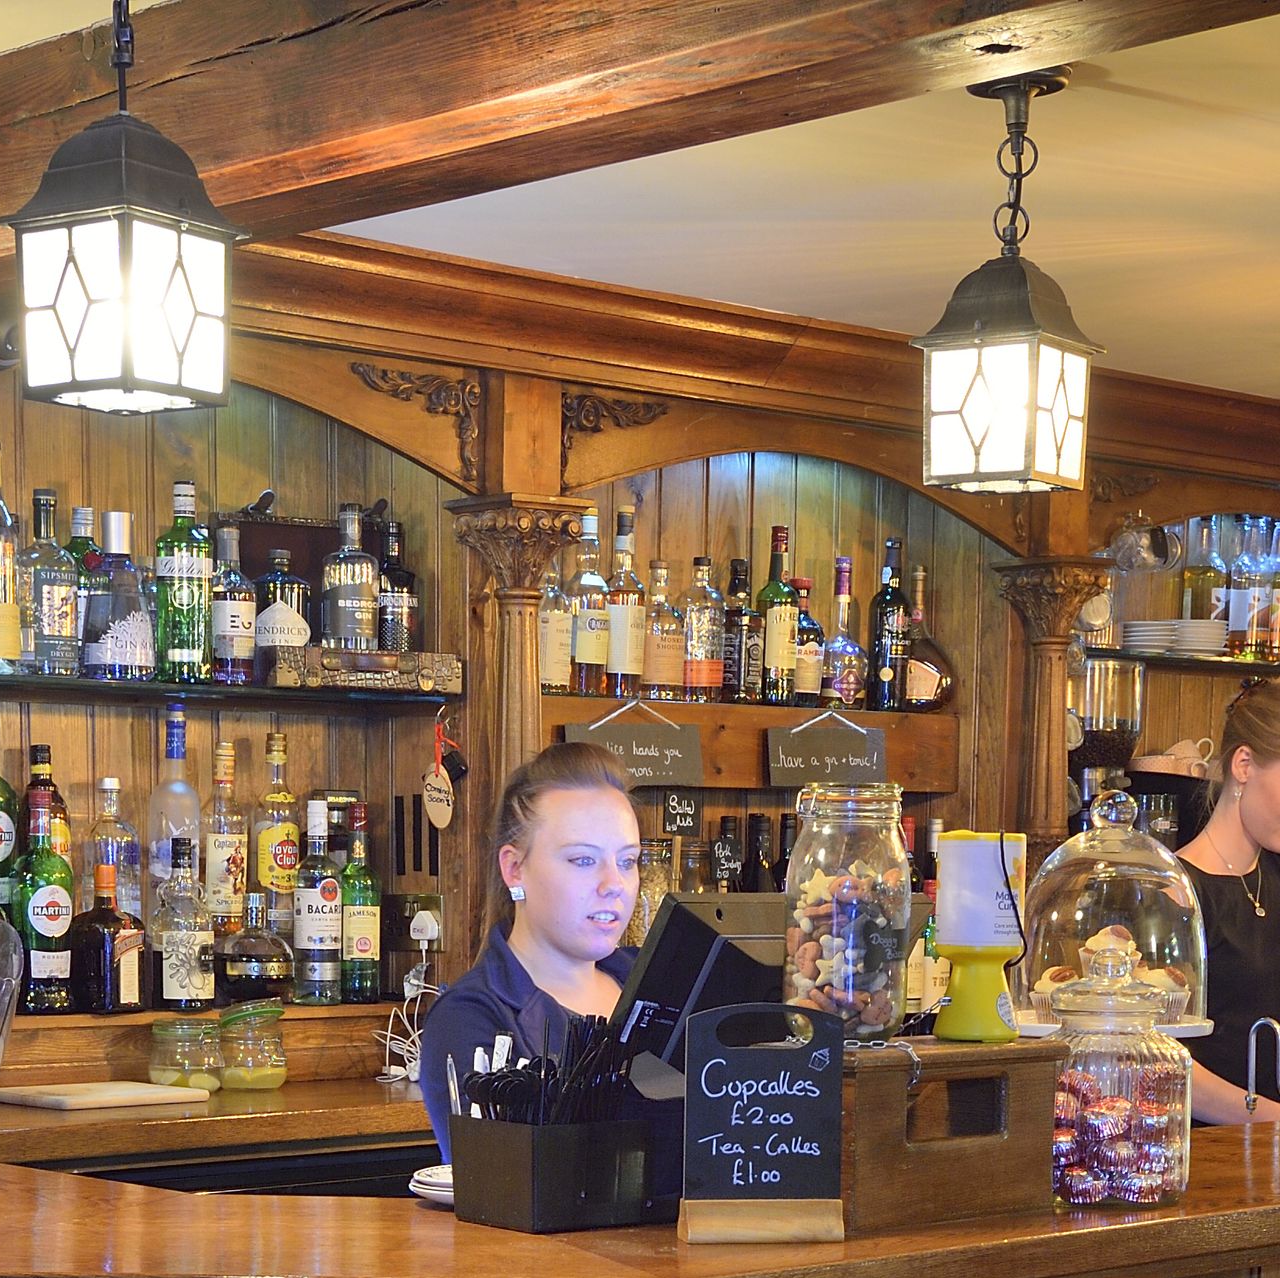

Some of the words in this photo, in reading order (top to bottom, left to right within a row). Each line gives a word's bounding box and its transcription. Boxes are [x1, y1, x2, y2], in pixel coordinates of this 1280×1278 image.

[338, 599, 378, 609] BEDROC
[354, 611, 372, 620] GIN
[115, 640, 136, 649] GIN
[632, 740, 660, 756] hands
[663, 749, 683, 765] you
[810, 756, 820, 766] a
[276, 855, 296, 865] Club
[33, 905, 70, 916] MARTINI
[869, 932, 898, 949] Doggy
